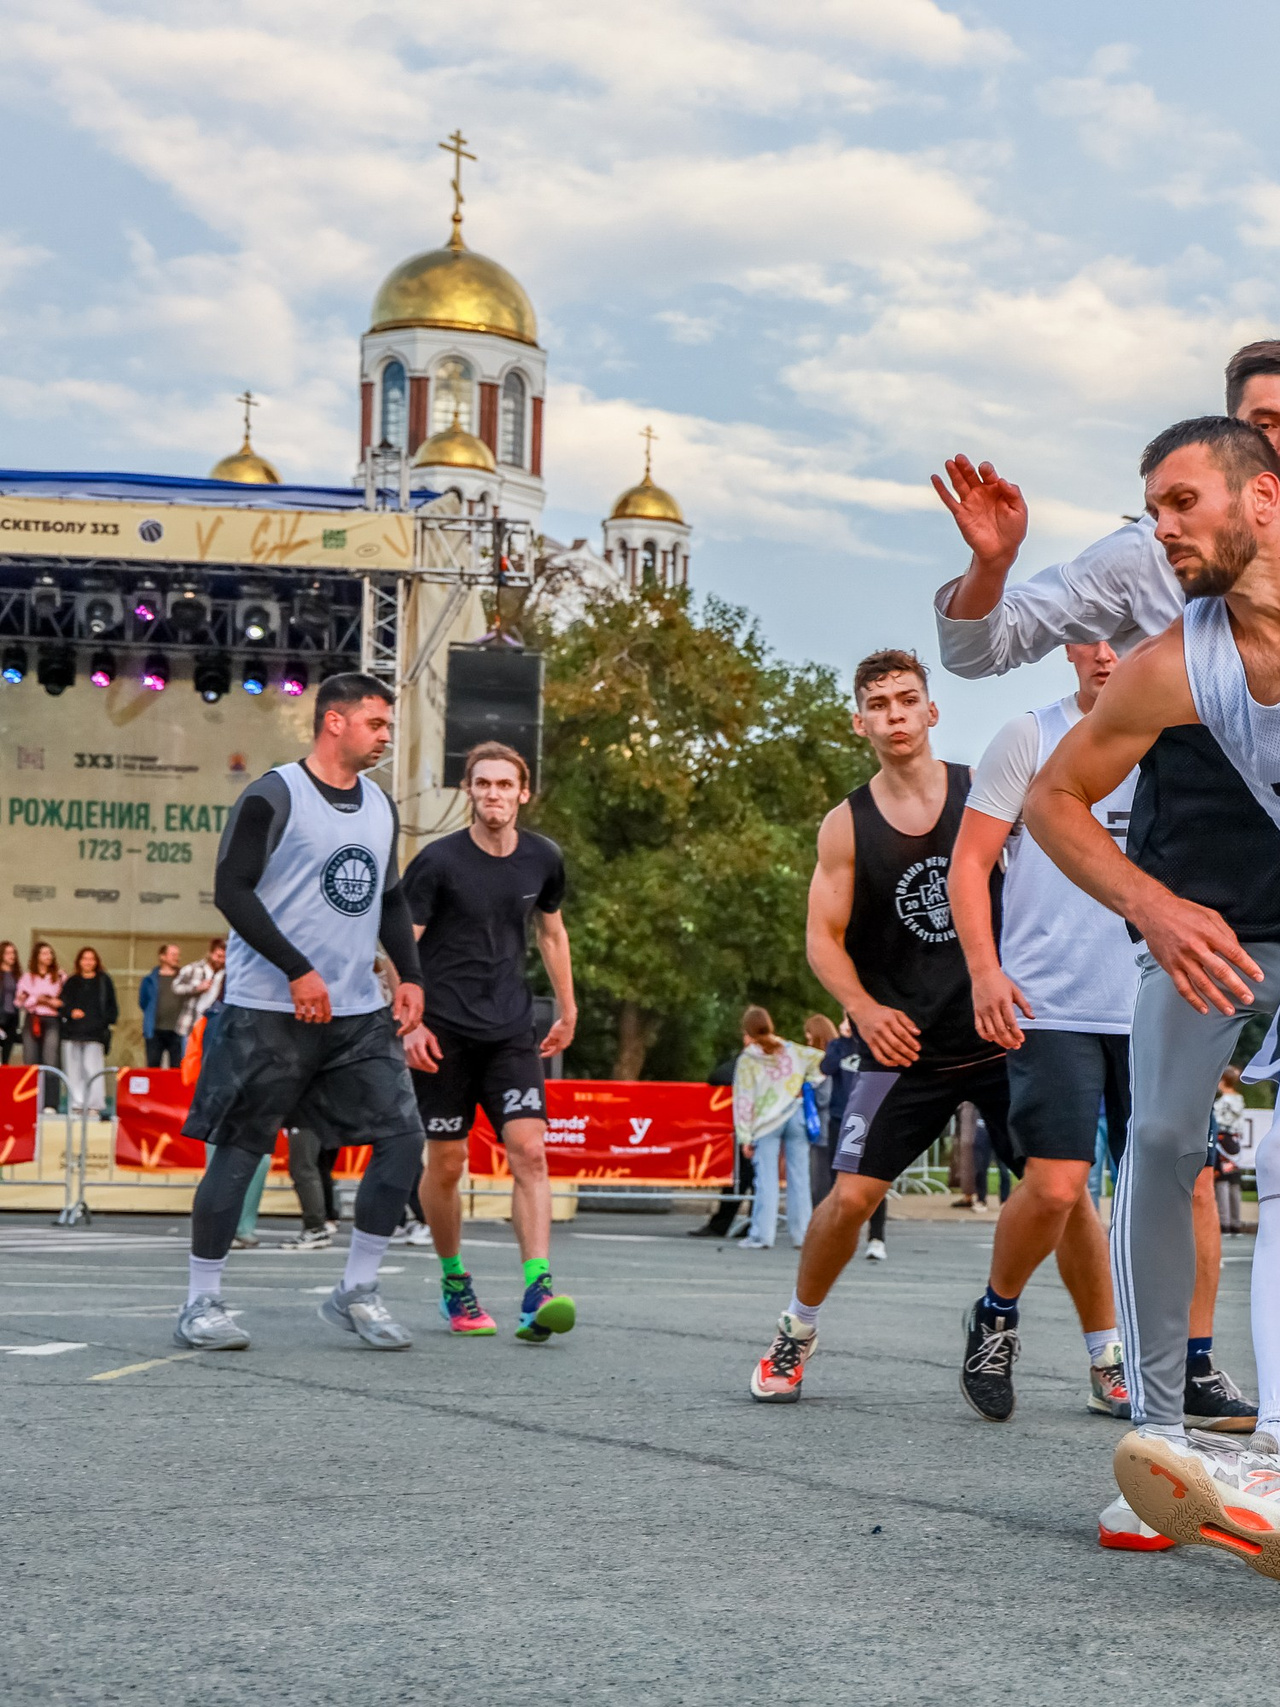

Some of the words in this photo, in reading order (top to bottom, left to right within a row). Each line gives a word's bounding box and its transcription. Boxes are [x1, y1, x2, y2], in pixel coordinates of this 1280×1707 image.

[0, 518, 86, 534] СКЕТБОЛУ
[8, 797, 157, 834] РОЖДЕНИЯ,
[164, 803, 234, 834] ЕКАТ
[77, 838, 123, 862] 1723
[145, 841, 193, 864] 2025
[895, 862, 925, 895] BRAND
[925, 856, 949, 868] NEW
[904, 899, 920, 912] 20
[903, 917, 957, 943] EKATERIN
[502, 1088, 542, 1115] 24
[547, 1115, 590, 1131] rands'
[840, 1113, 870, 1158] 2
[543, 1128, 586, 1145] tories
